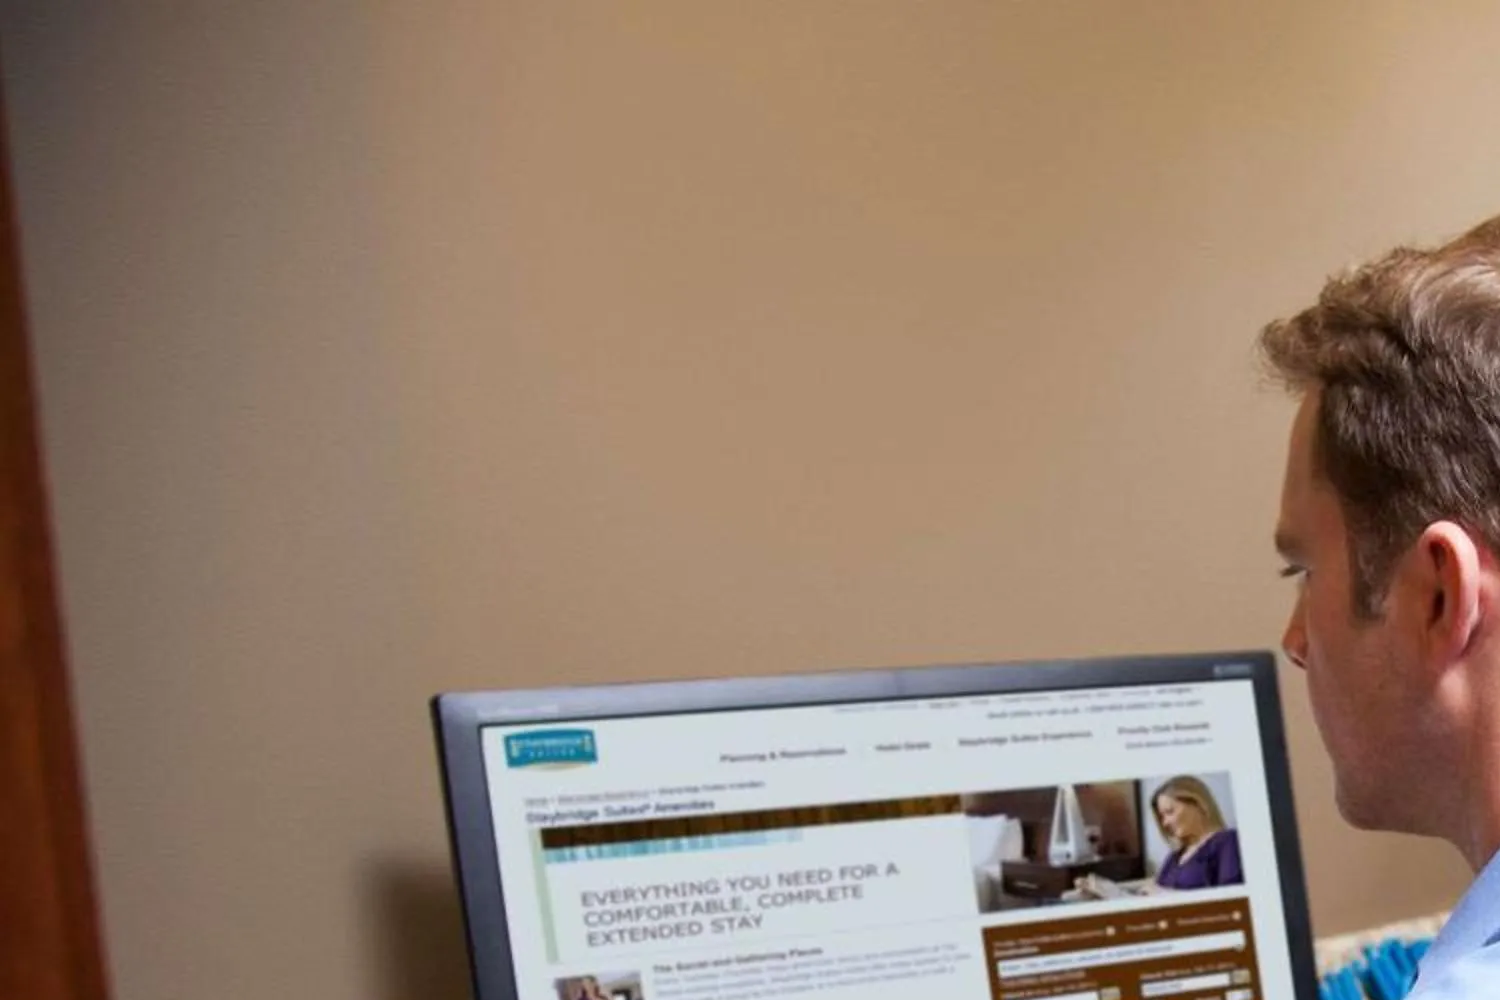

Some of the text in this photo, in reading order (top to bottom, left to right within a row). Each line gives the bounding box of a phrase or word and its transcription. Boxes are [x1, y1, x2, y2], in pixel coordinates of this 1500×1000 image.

[580, 861, 901, 908] EVERYTHING YOU NEED FOR A
[583, 884, 864, 929] COMFORTABLE, COMPLETE
[586, 914, 763, 948] EXTENDED STAY
